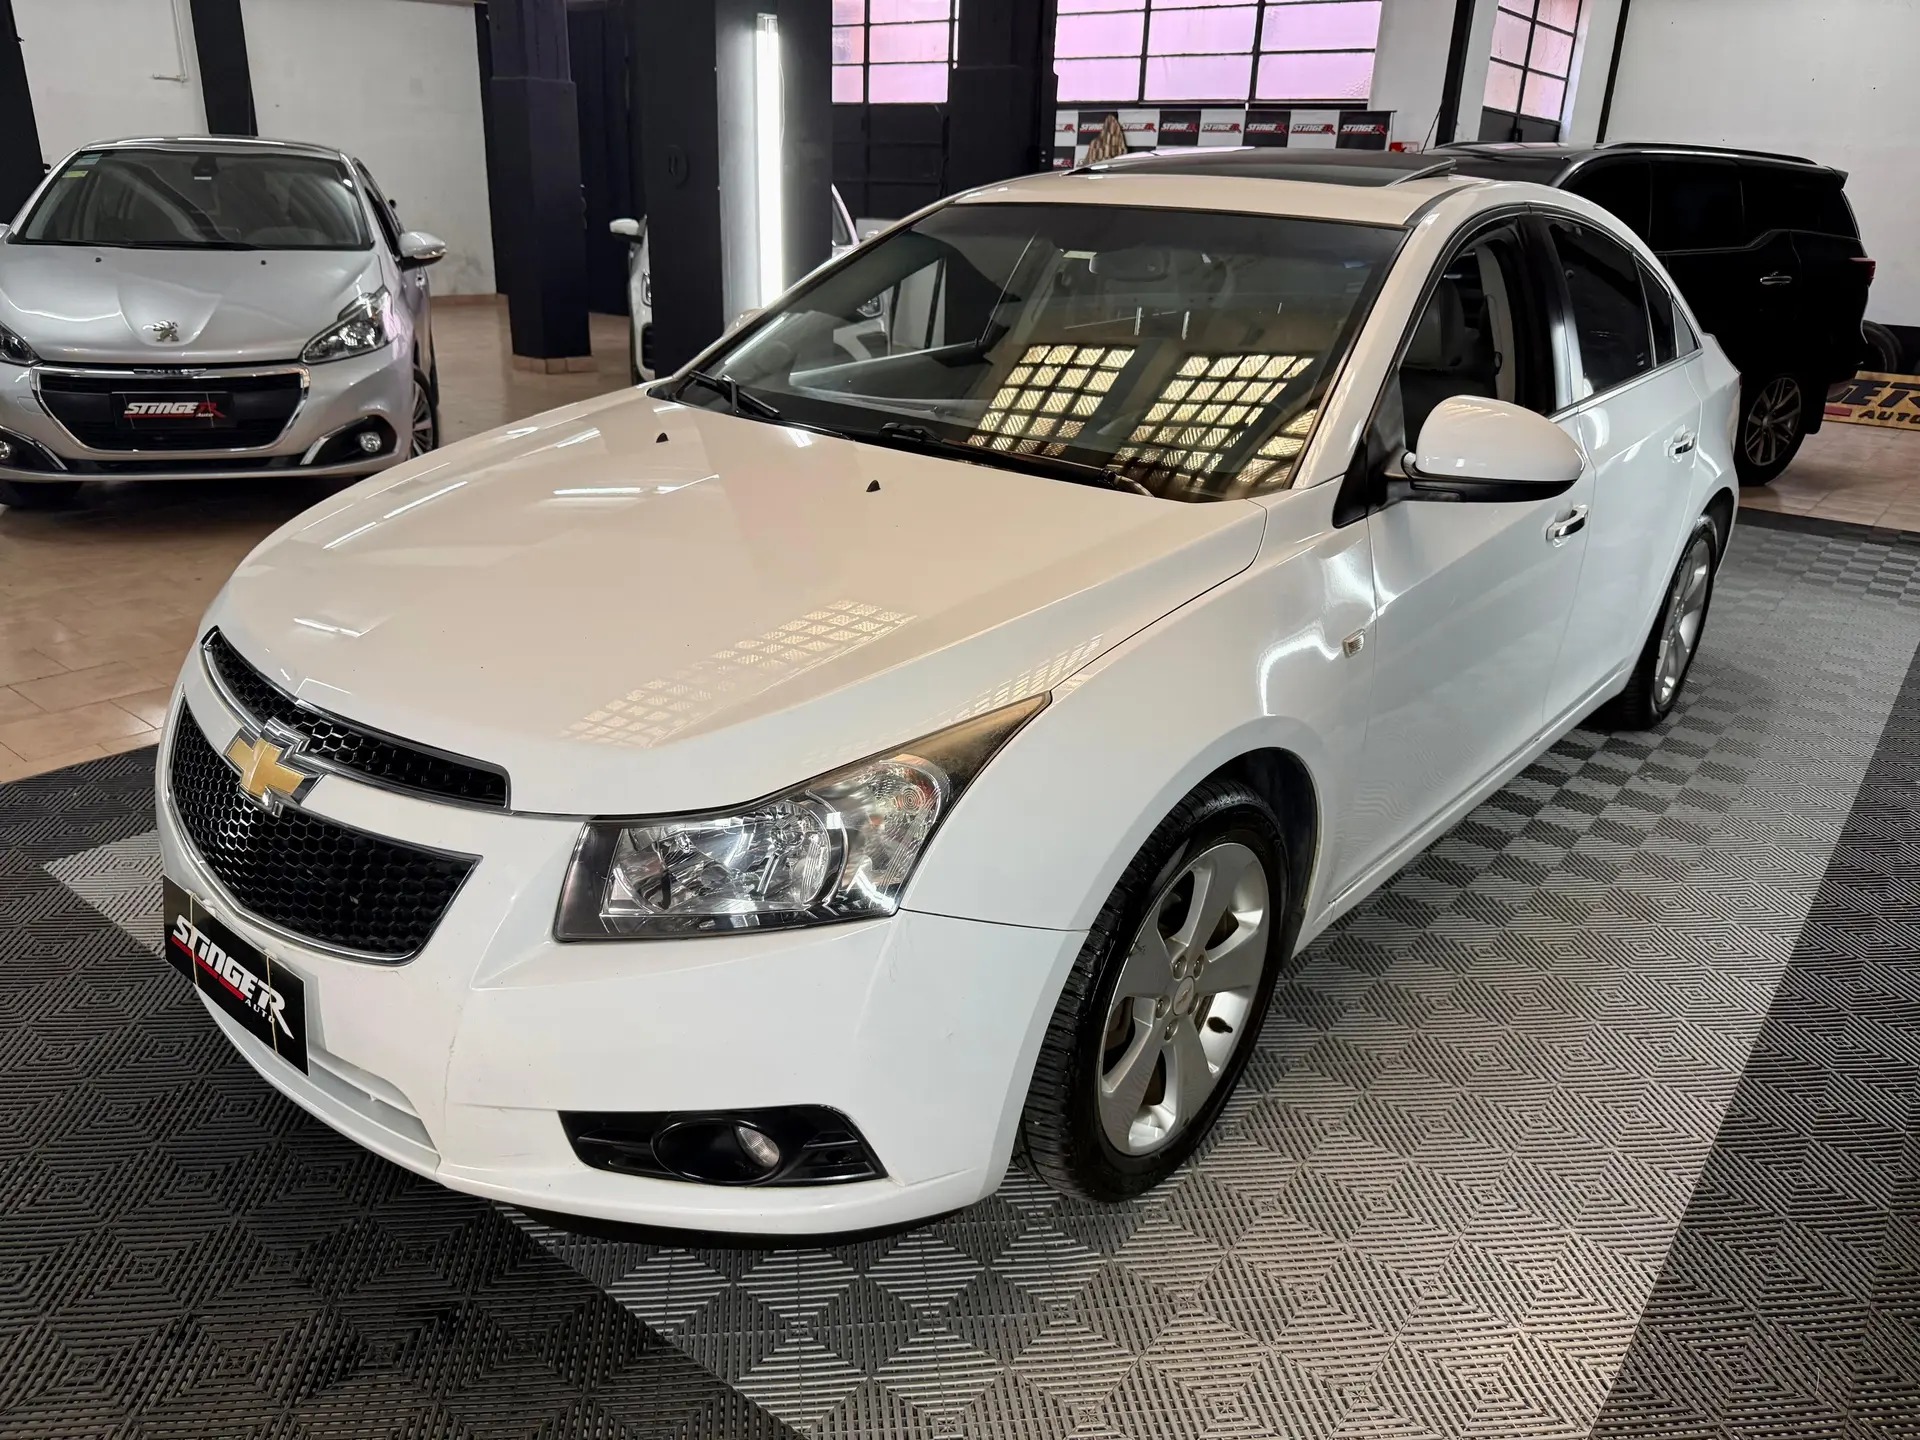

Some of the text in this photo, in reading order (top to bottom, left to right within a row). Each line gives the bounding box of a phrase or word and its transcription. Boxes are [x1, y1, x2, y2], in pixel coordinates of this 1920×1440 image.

[1340, 124, 1386, 135] STINGER
[124, 402, 226, 418] STINGER
[172, 914, 295, 1040] STINGER
[245, 998, 276, 1023] AUTO
